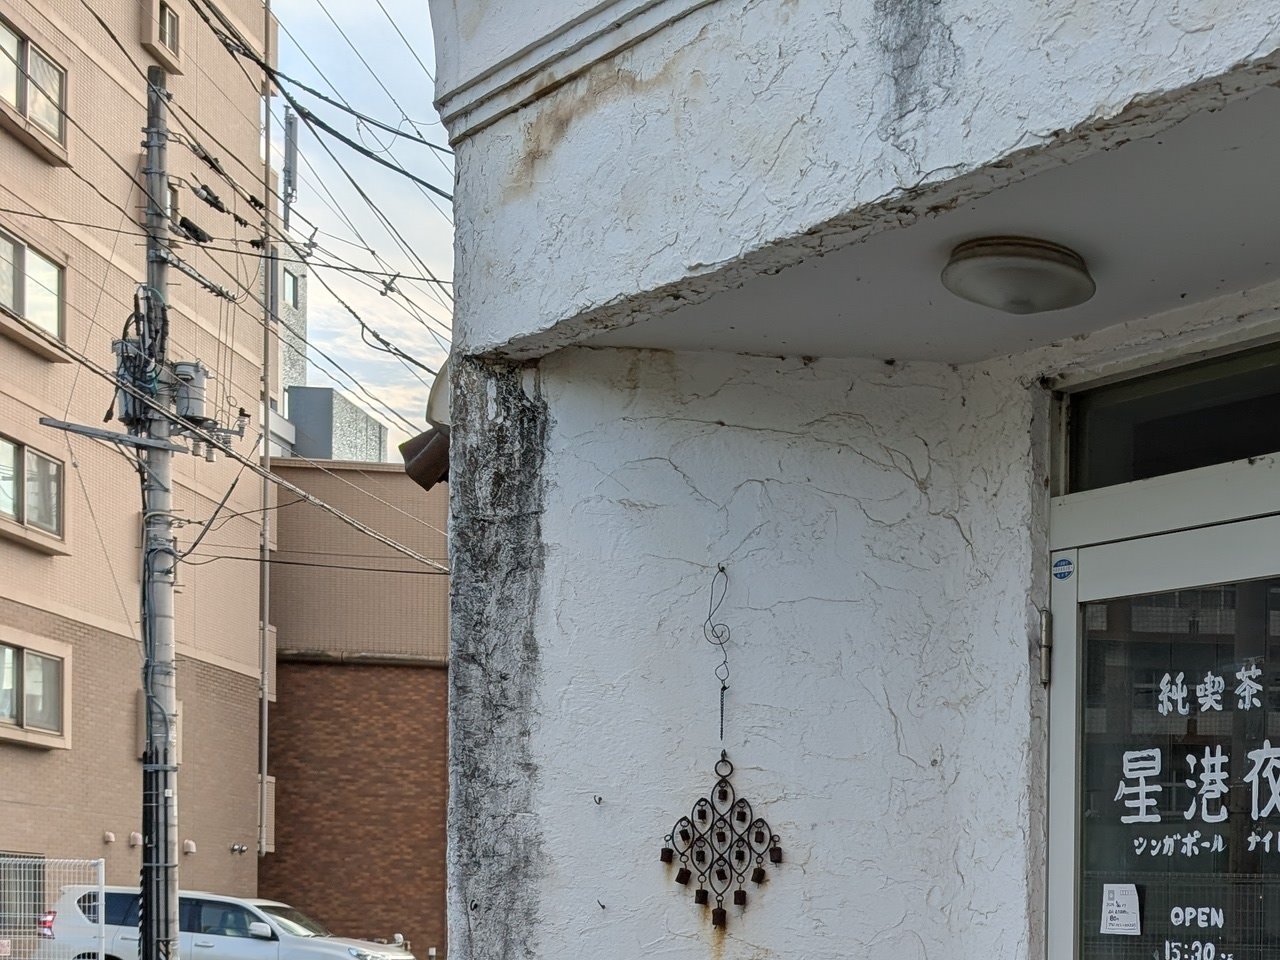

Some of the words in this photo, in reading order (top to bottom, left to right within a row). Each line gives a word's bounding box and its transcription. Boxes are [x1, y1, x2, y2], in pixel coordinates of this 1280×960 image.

[1157, 663, 1264, 717] 純喫茶
[1170, 906, 1224, 928] OPEN
